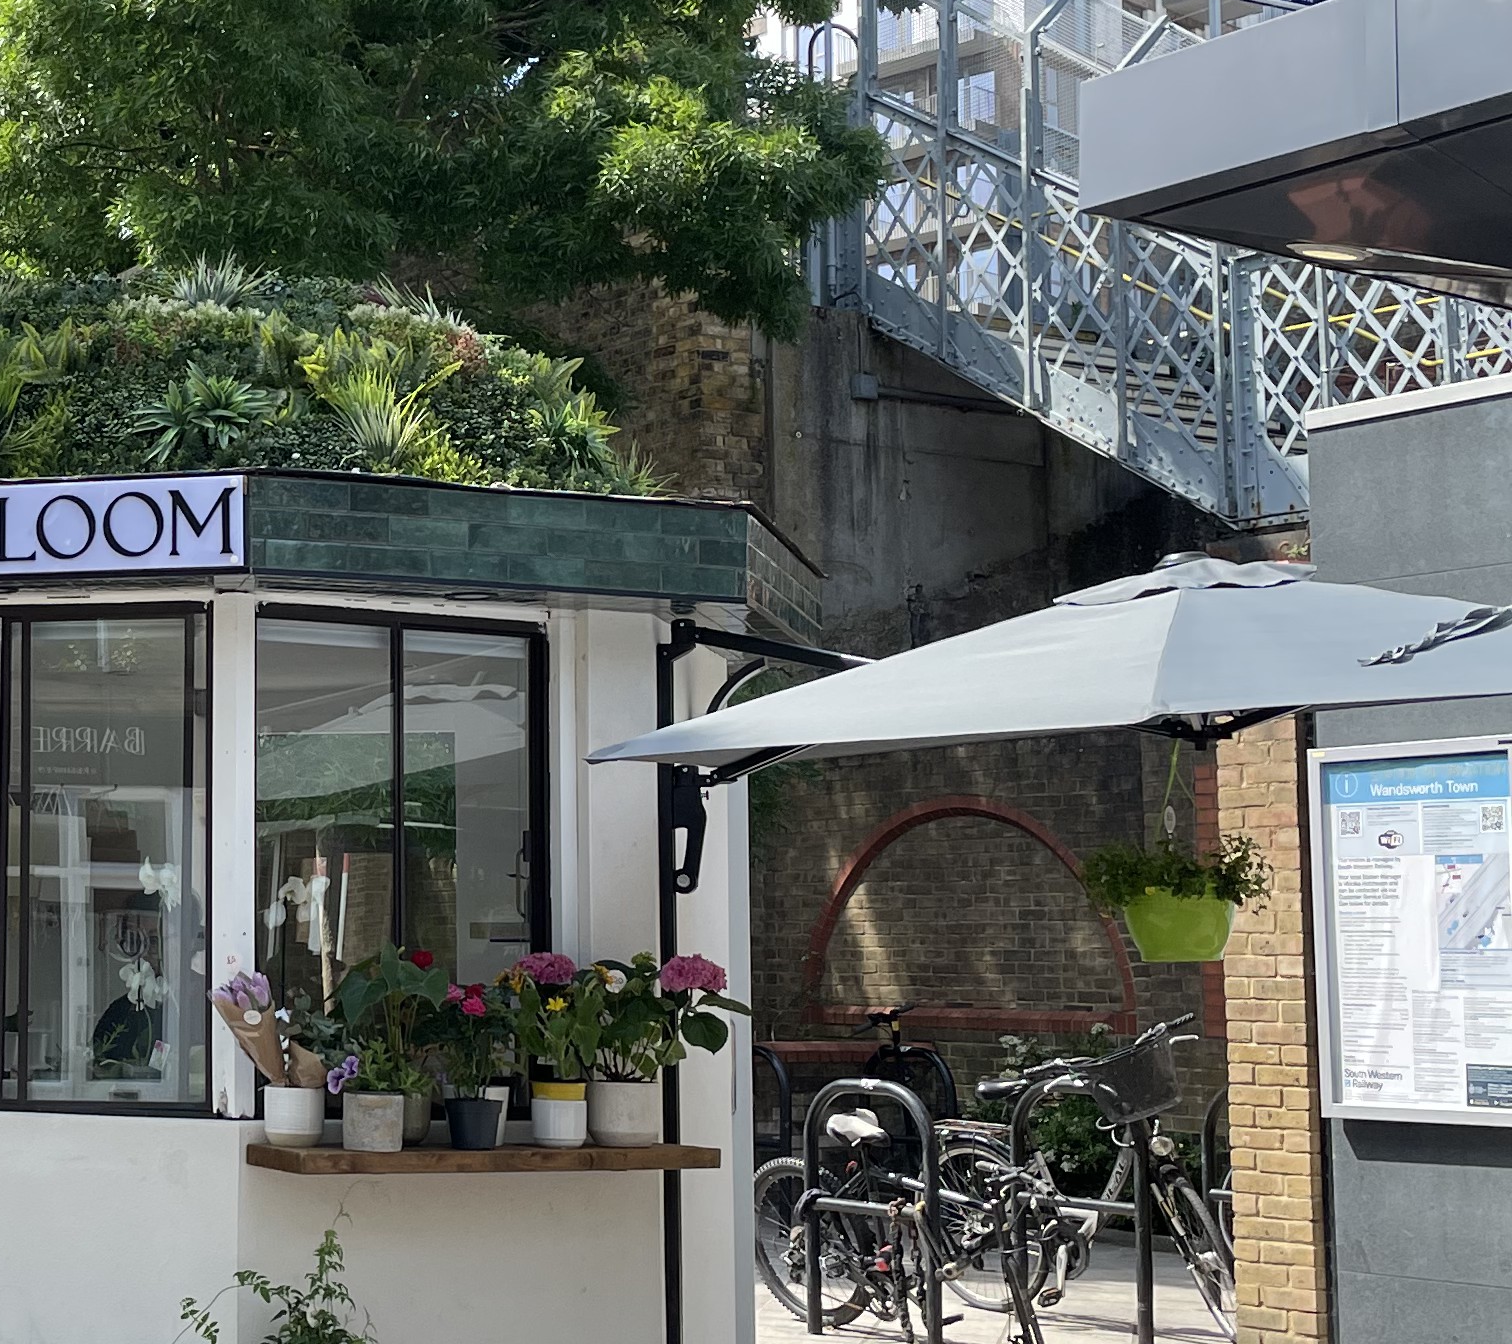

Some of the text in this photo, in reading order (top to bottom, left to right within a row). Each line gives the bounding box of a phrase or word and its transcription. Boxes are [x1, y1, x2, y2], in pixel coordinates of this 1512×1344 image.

[1369, 780, 1479, 797] Wandsworth Town
[1344, 1068, 1403, 1081] South Western
[1352, 1079, 1384, 1092] Railway
